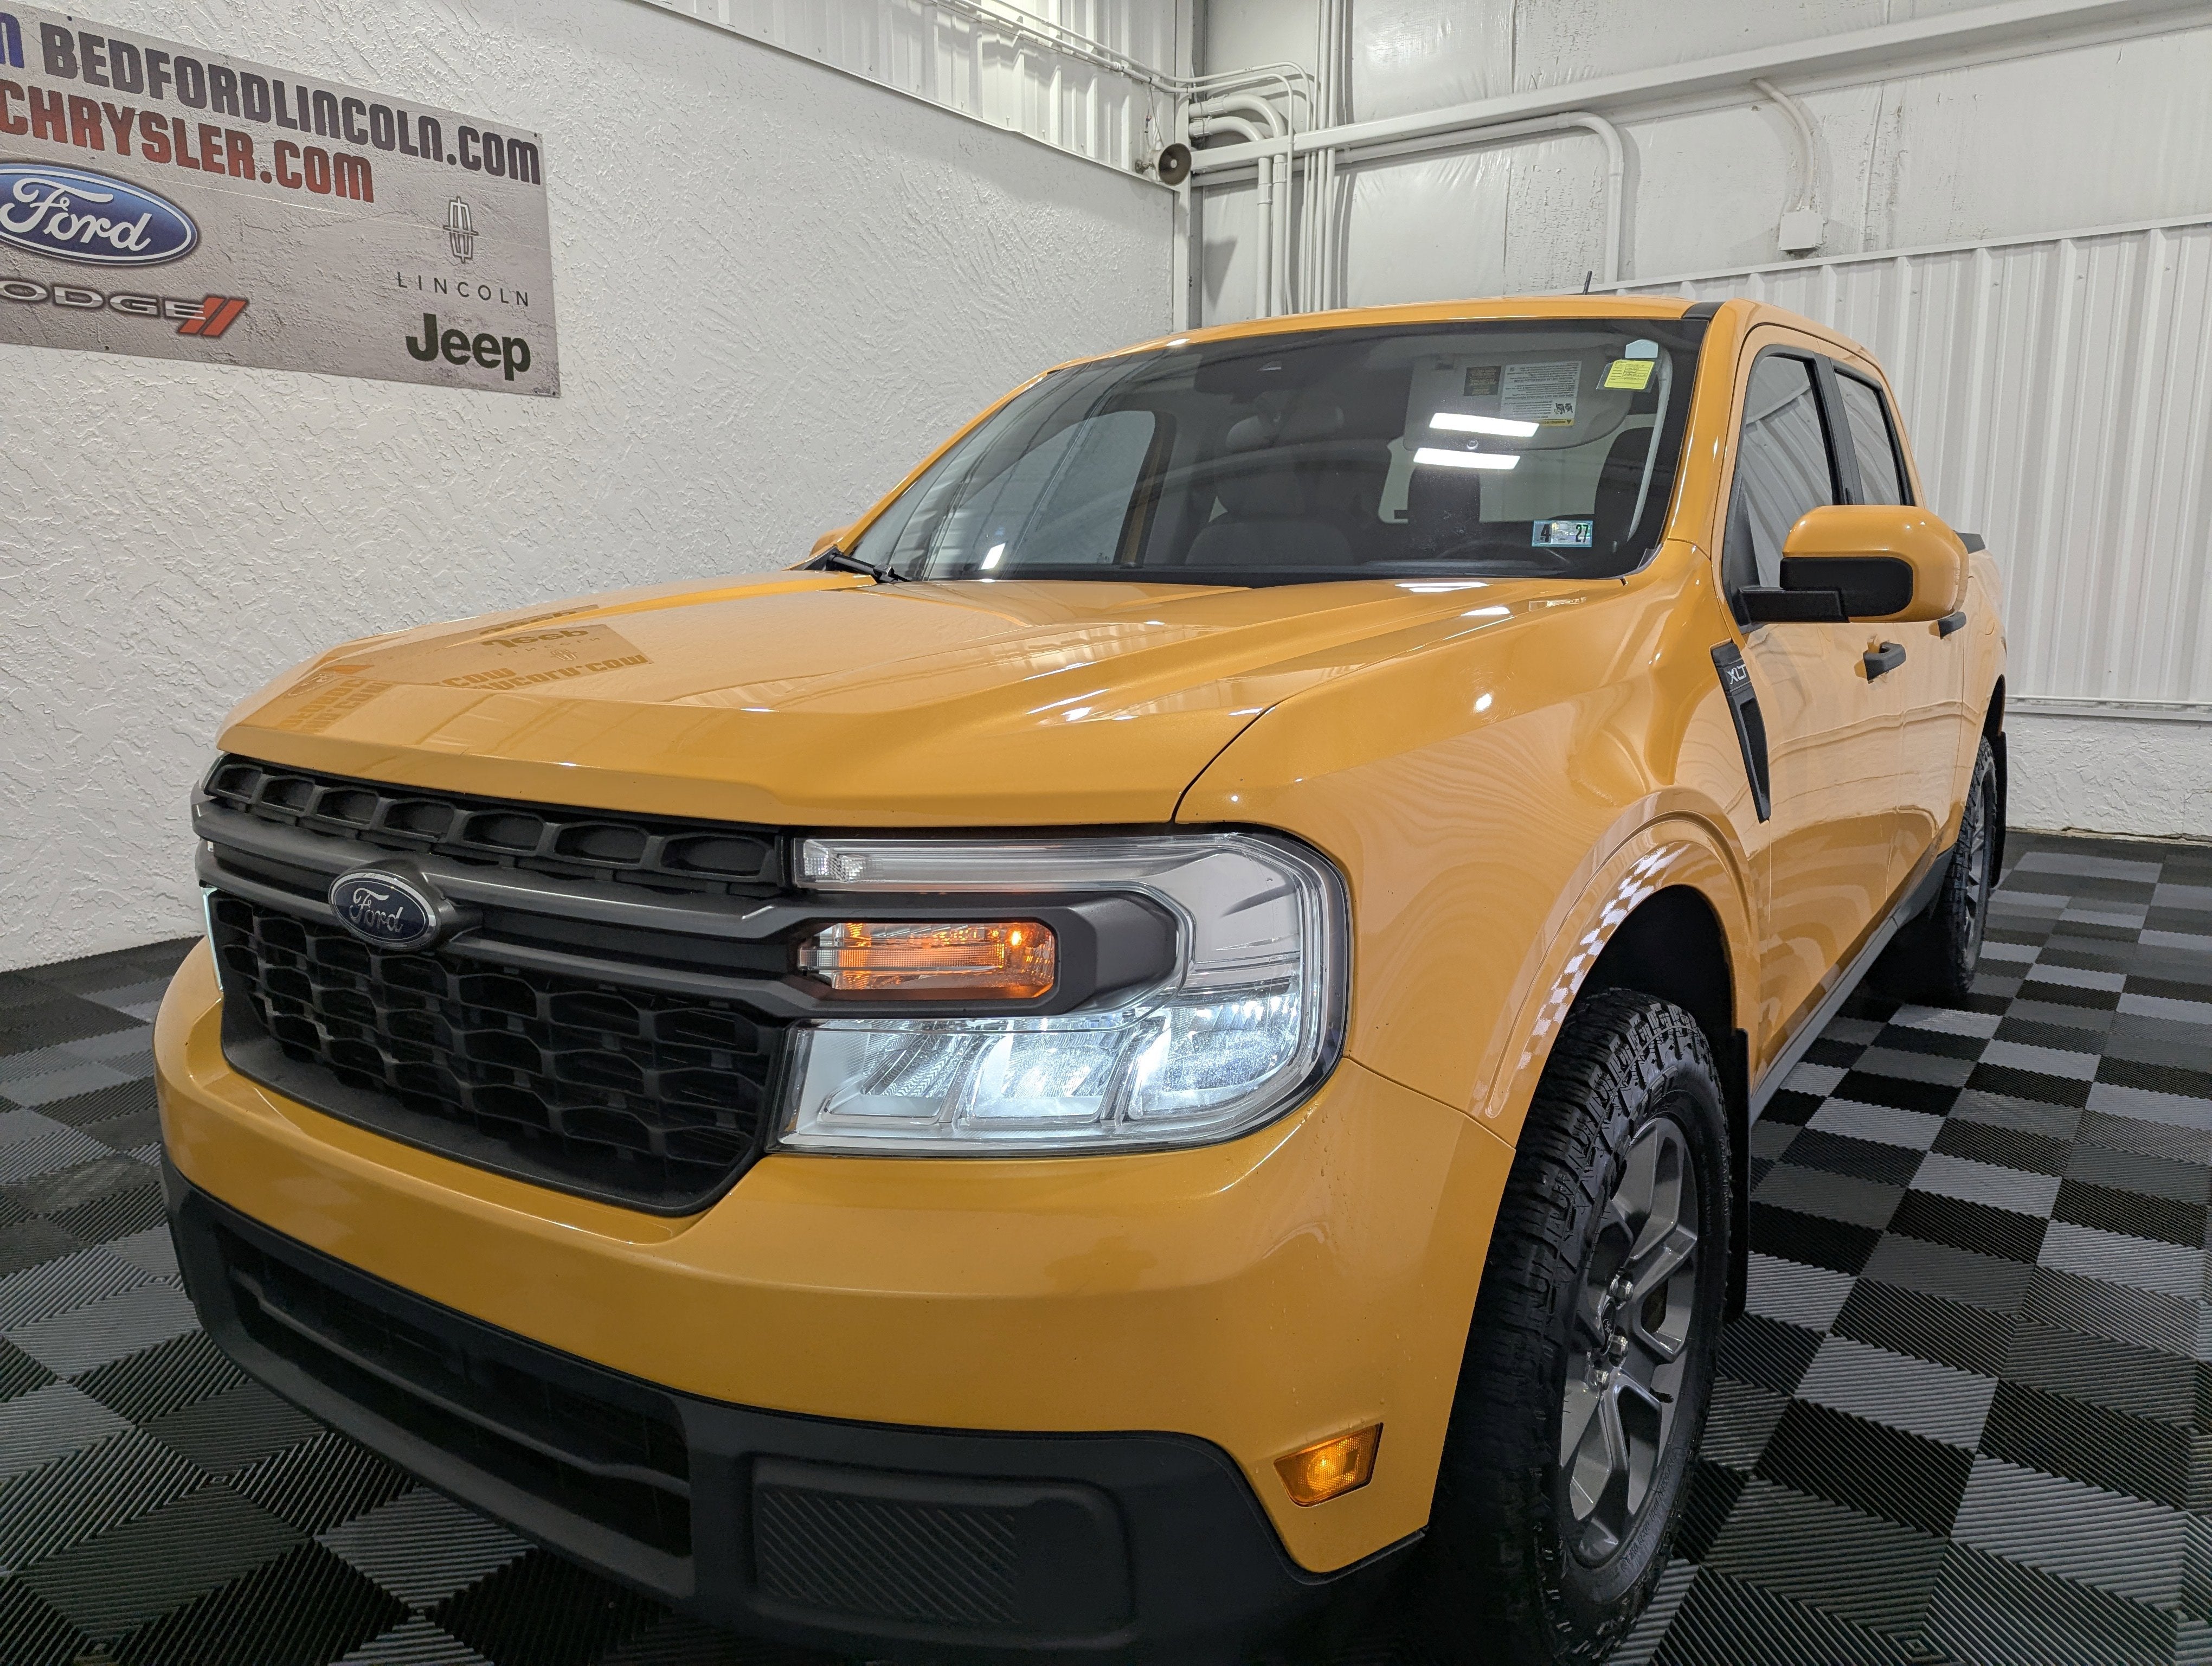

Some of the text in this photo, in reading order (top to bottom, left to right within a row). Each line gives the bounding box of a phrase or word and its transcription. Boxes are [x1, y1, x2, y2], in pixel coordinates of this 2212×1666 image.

[40, 22, 541, 185] BEDFORDLINCOLN.COM
[0, 178, 152, 251] Ford
[0, 280, 206, 321] ODGE
[397, 272, 529, 306] LINCOLN
[406, 313, 531, 381] Jeep
[1575, 524, 1589, 542] 27
[1726, 664, 1746, 684] XLT
[349, 887, 403, 932] Ford
